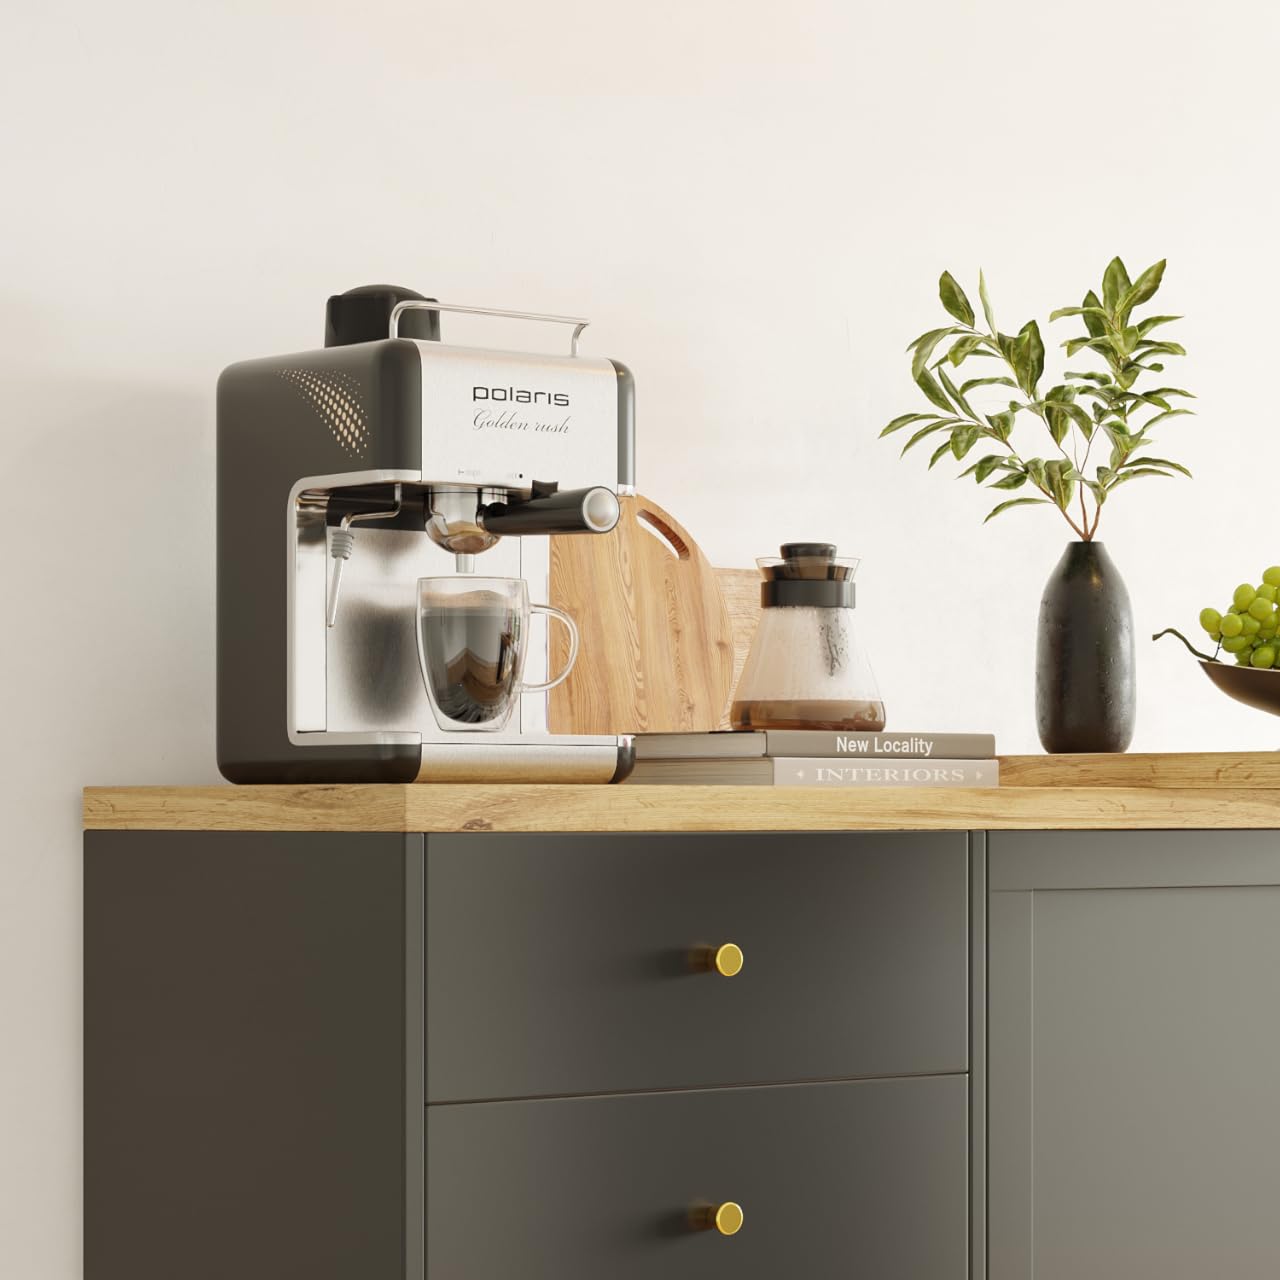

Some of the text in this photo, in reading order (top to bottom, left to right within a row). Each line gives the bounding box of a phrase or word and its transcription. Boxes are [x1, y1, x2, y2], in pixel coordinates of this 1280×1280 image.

[473, 386, 569, 406] polaris
[472, 407, 572, 434] Golden rush
[836, 736, 933, 756] New Locality
[816, 768, 965, 782] INTERIORS
